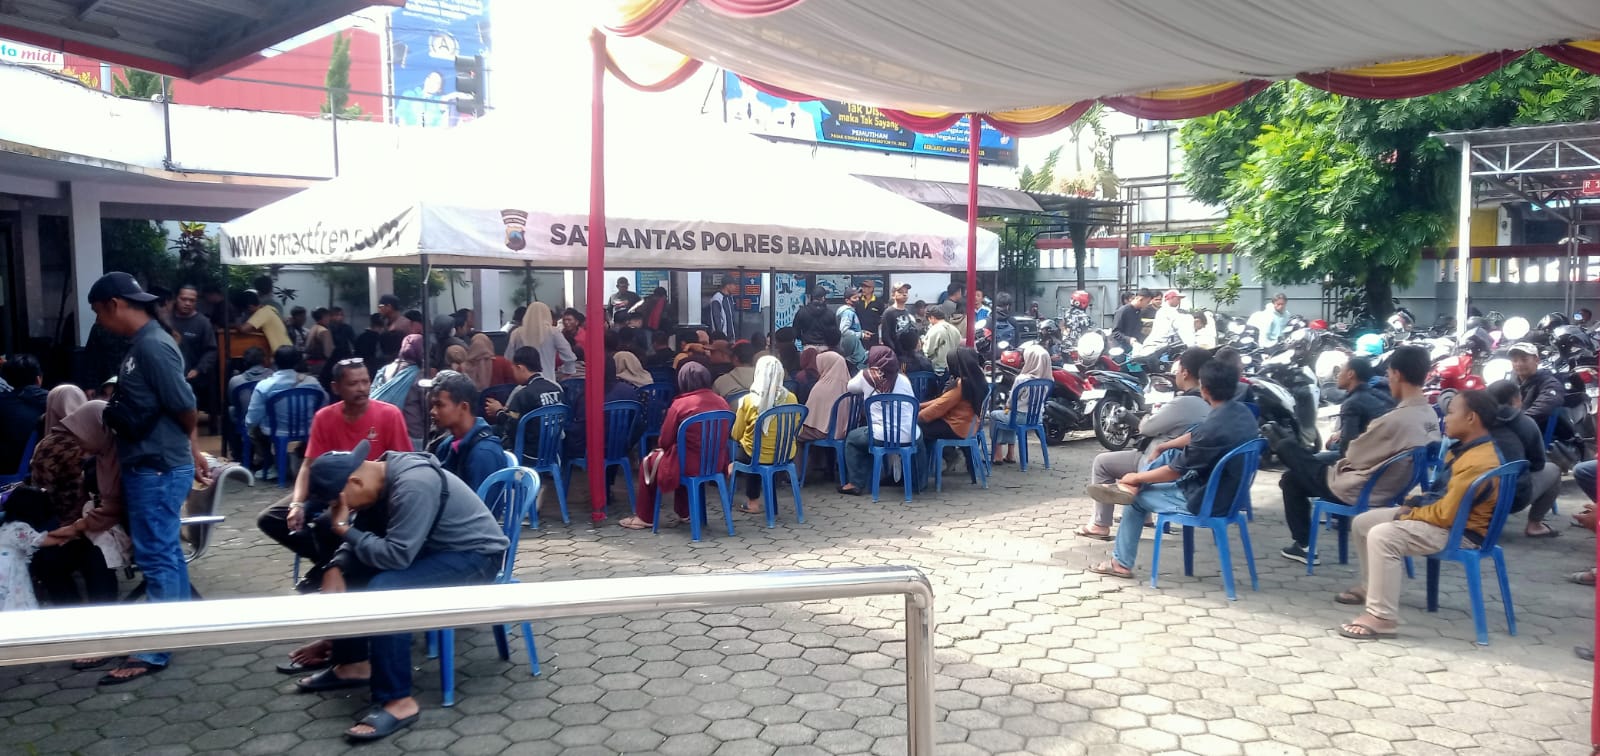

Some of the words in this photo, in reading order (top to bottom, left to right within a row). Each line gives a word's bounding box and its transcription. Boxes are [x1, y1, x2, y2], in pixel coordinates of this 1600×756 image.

[20, 49, 57, 63] midi
[838, 112, 859, 123] maka
[861, 114, 873, 125] Tak
[874, 116, 900, 131] Sayang
[851, 129, 889, 140] PEMUTIHAN
[701, 231, 783, 254] POLRES
[787, 235, 933, 260] BANJARNEGARA
